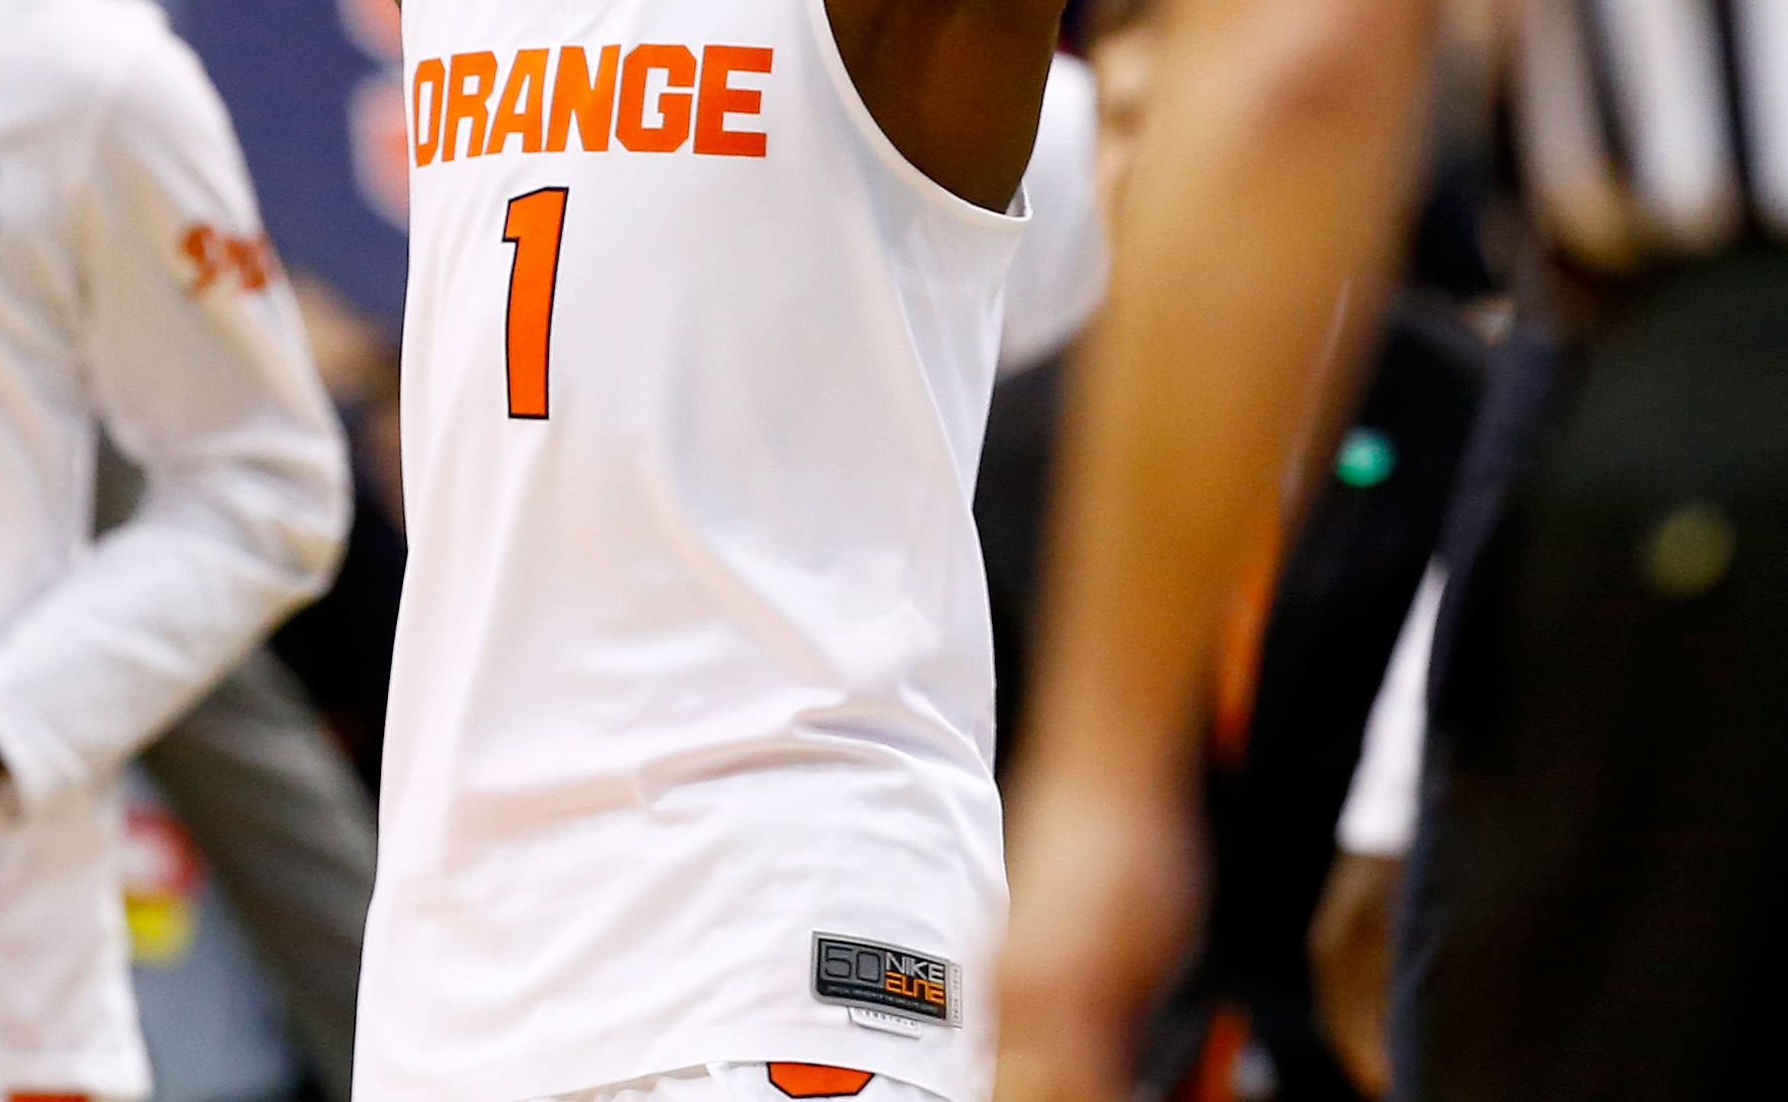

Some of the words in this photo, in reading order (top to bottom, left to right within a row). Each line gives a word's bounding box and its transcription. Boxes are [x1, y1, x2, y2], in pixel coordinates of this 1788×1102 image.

[412, 43, 774, 168] ORANGE
[502, 186, 570, 420] 1
[823, 945, 882, 984] 50
[885, 951, 945, 983] NIKE
